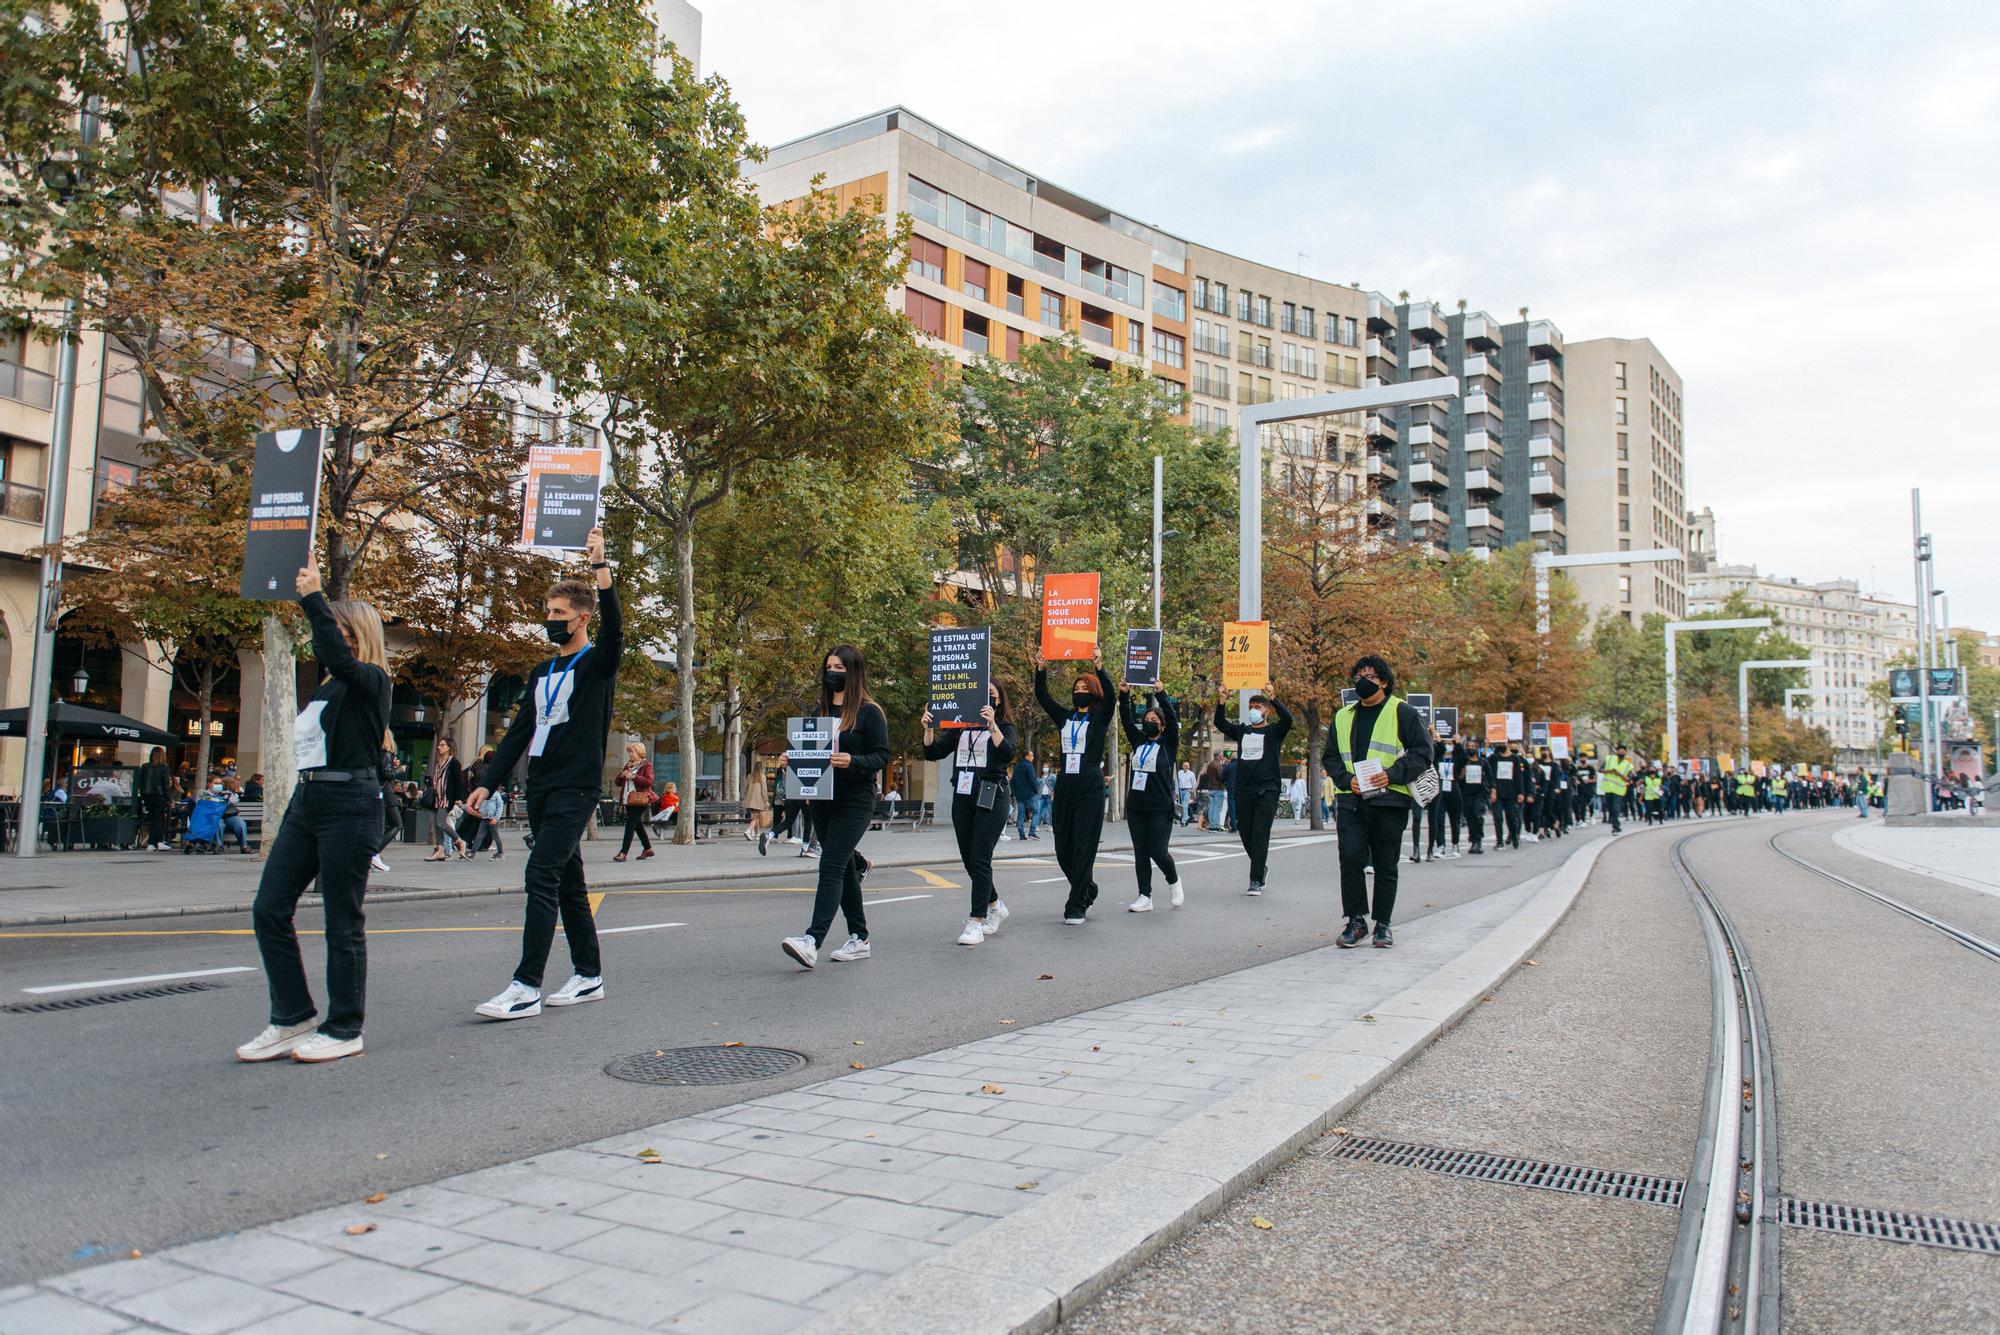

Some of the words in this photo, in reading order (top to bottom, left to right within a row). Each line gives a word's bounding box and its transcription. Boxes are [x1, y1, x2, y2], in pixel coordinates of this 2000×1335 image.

[532, 462, 570, 470] EXISTIENDO
[273, 491, 304, 504] PERSONAS
[554, 493, 594, 501] ESCLAVITUD
[252, 507, 273, 518] SIENDO
[273, 505, 310, 517] EXPLOTADAS
[543, 508, 582, 516] EXISTIENDO
[1048, 598, 1093, 606] ESCLAVITUD
[1047, 617, 1090, 625] EXISTIENDO
[933, 635, 942, 643] SE
[943, 634, 969, 642] ESTIMA
[944, 644, 966, 652] TRATA
[1227, 635, 1250, 653] 1%
[932, 653, 970, 661] PERSONAS
[932, 664, 960, 672] GENERA
[962, 661, 977, 669] MÁS
[932, 683, 967, 691] MILLONES
[932, 693, 955, 701] EUROS
[942, 701, 959, 710] AÑO.
[101, 725, 140, 738] VIPS
